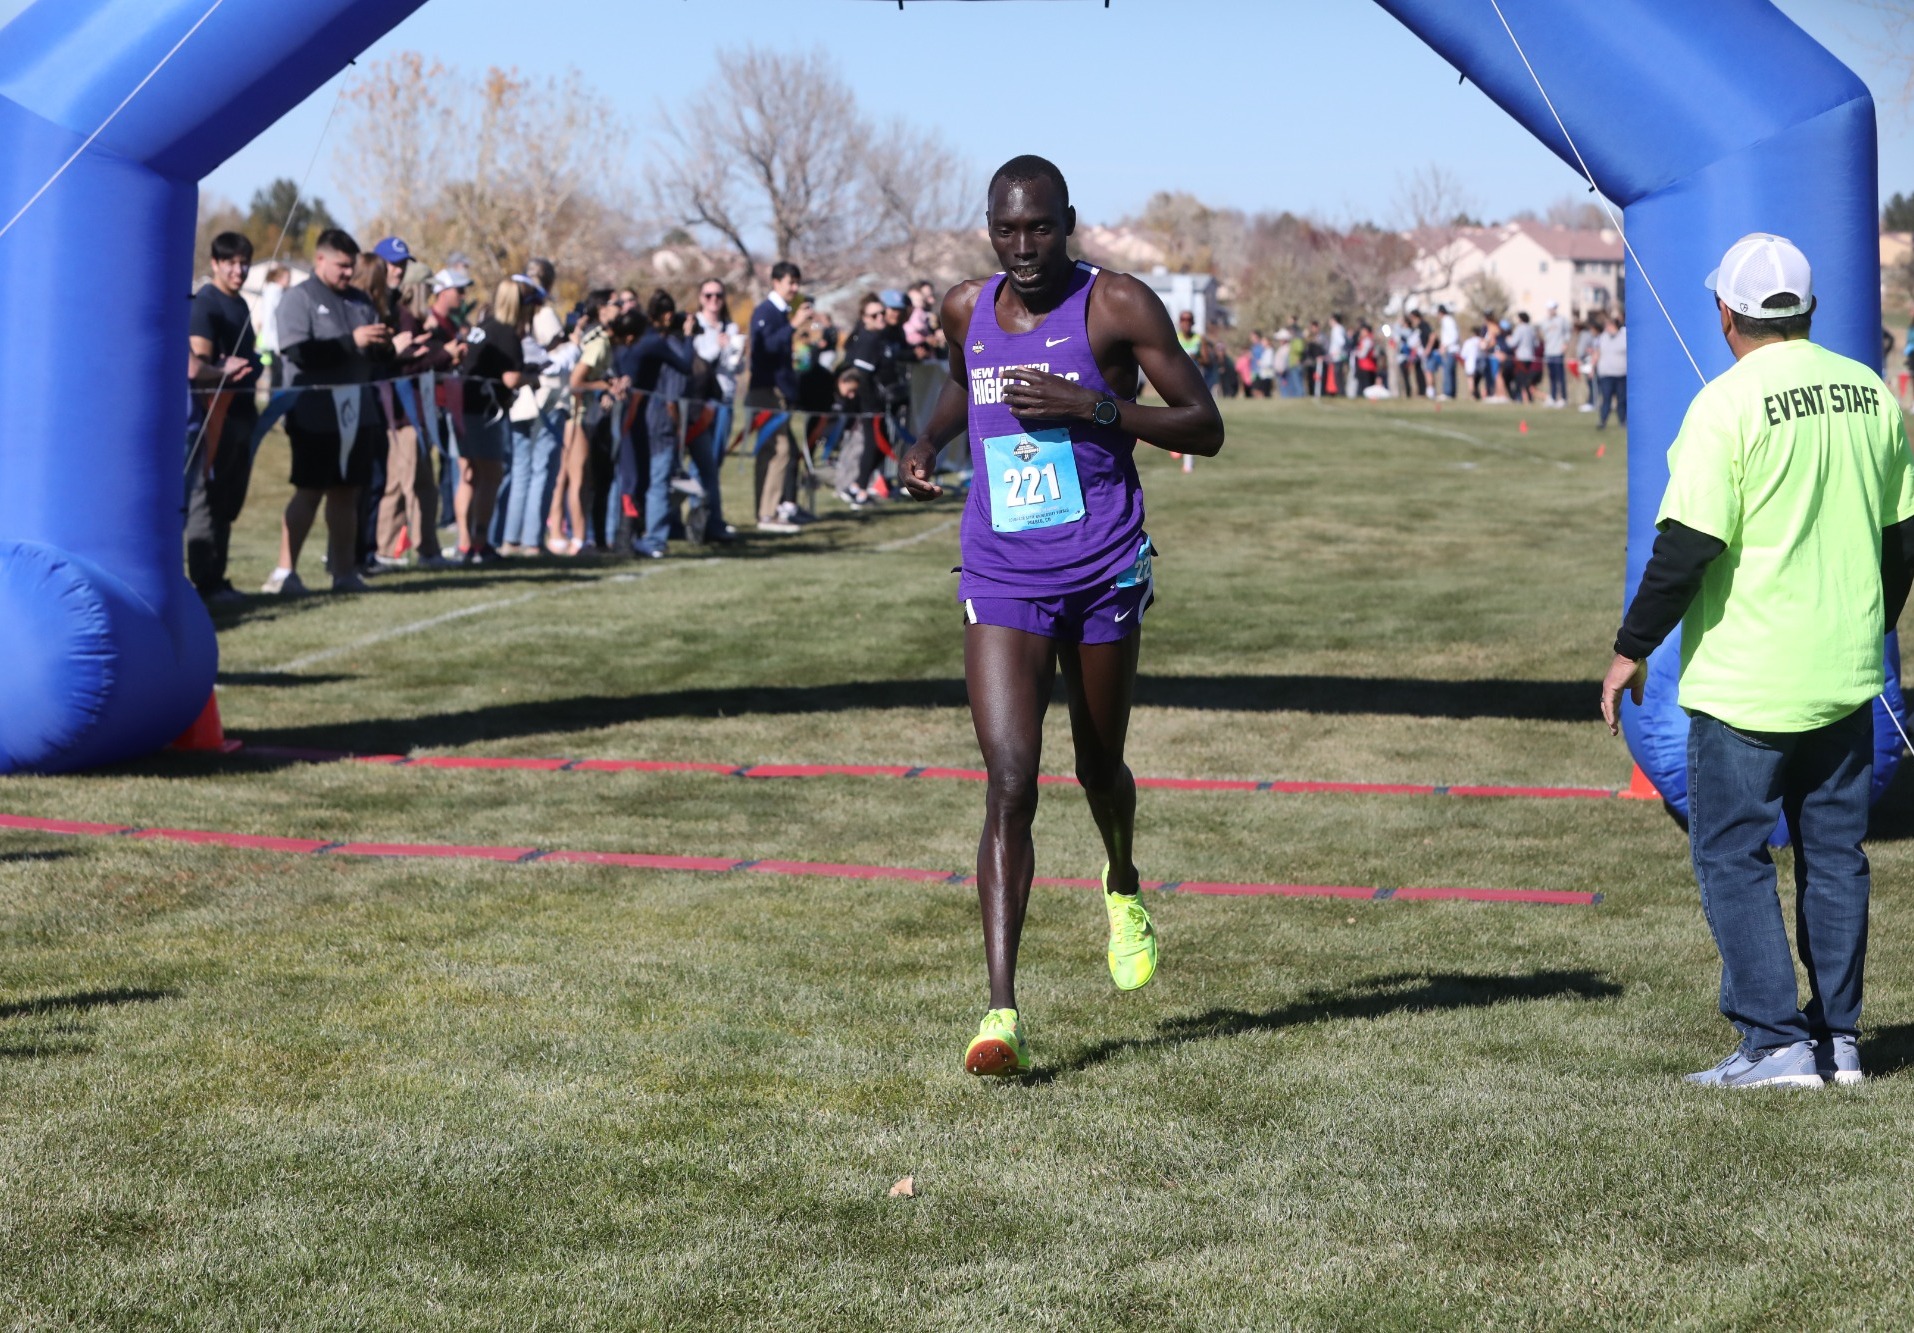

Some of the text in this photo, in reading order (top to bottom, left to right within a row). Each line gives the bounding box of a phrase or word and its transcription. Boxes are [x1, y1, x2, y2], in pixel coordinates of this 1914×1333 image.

[971, 367, 994, 379] NEW
[1764, 384, 1879, 426] EVENT STAFF
[1004, 463, 1061, 507] 221
